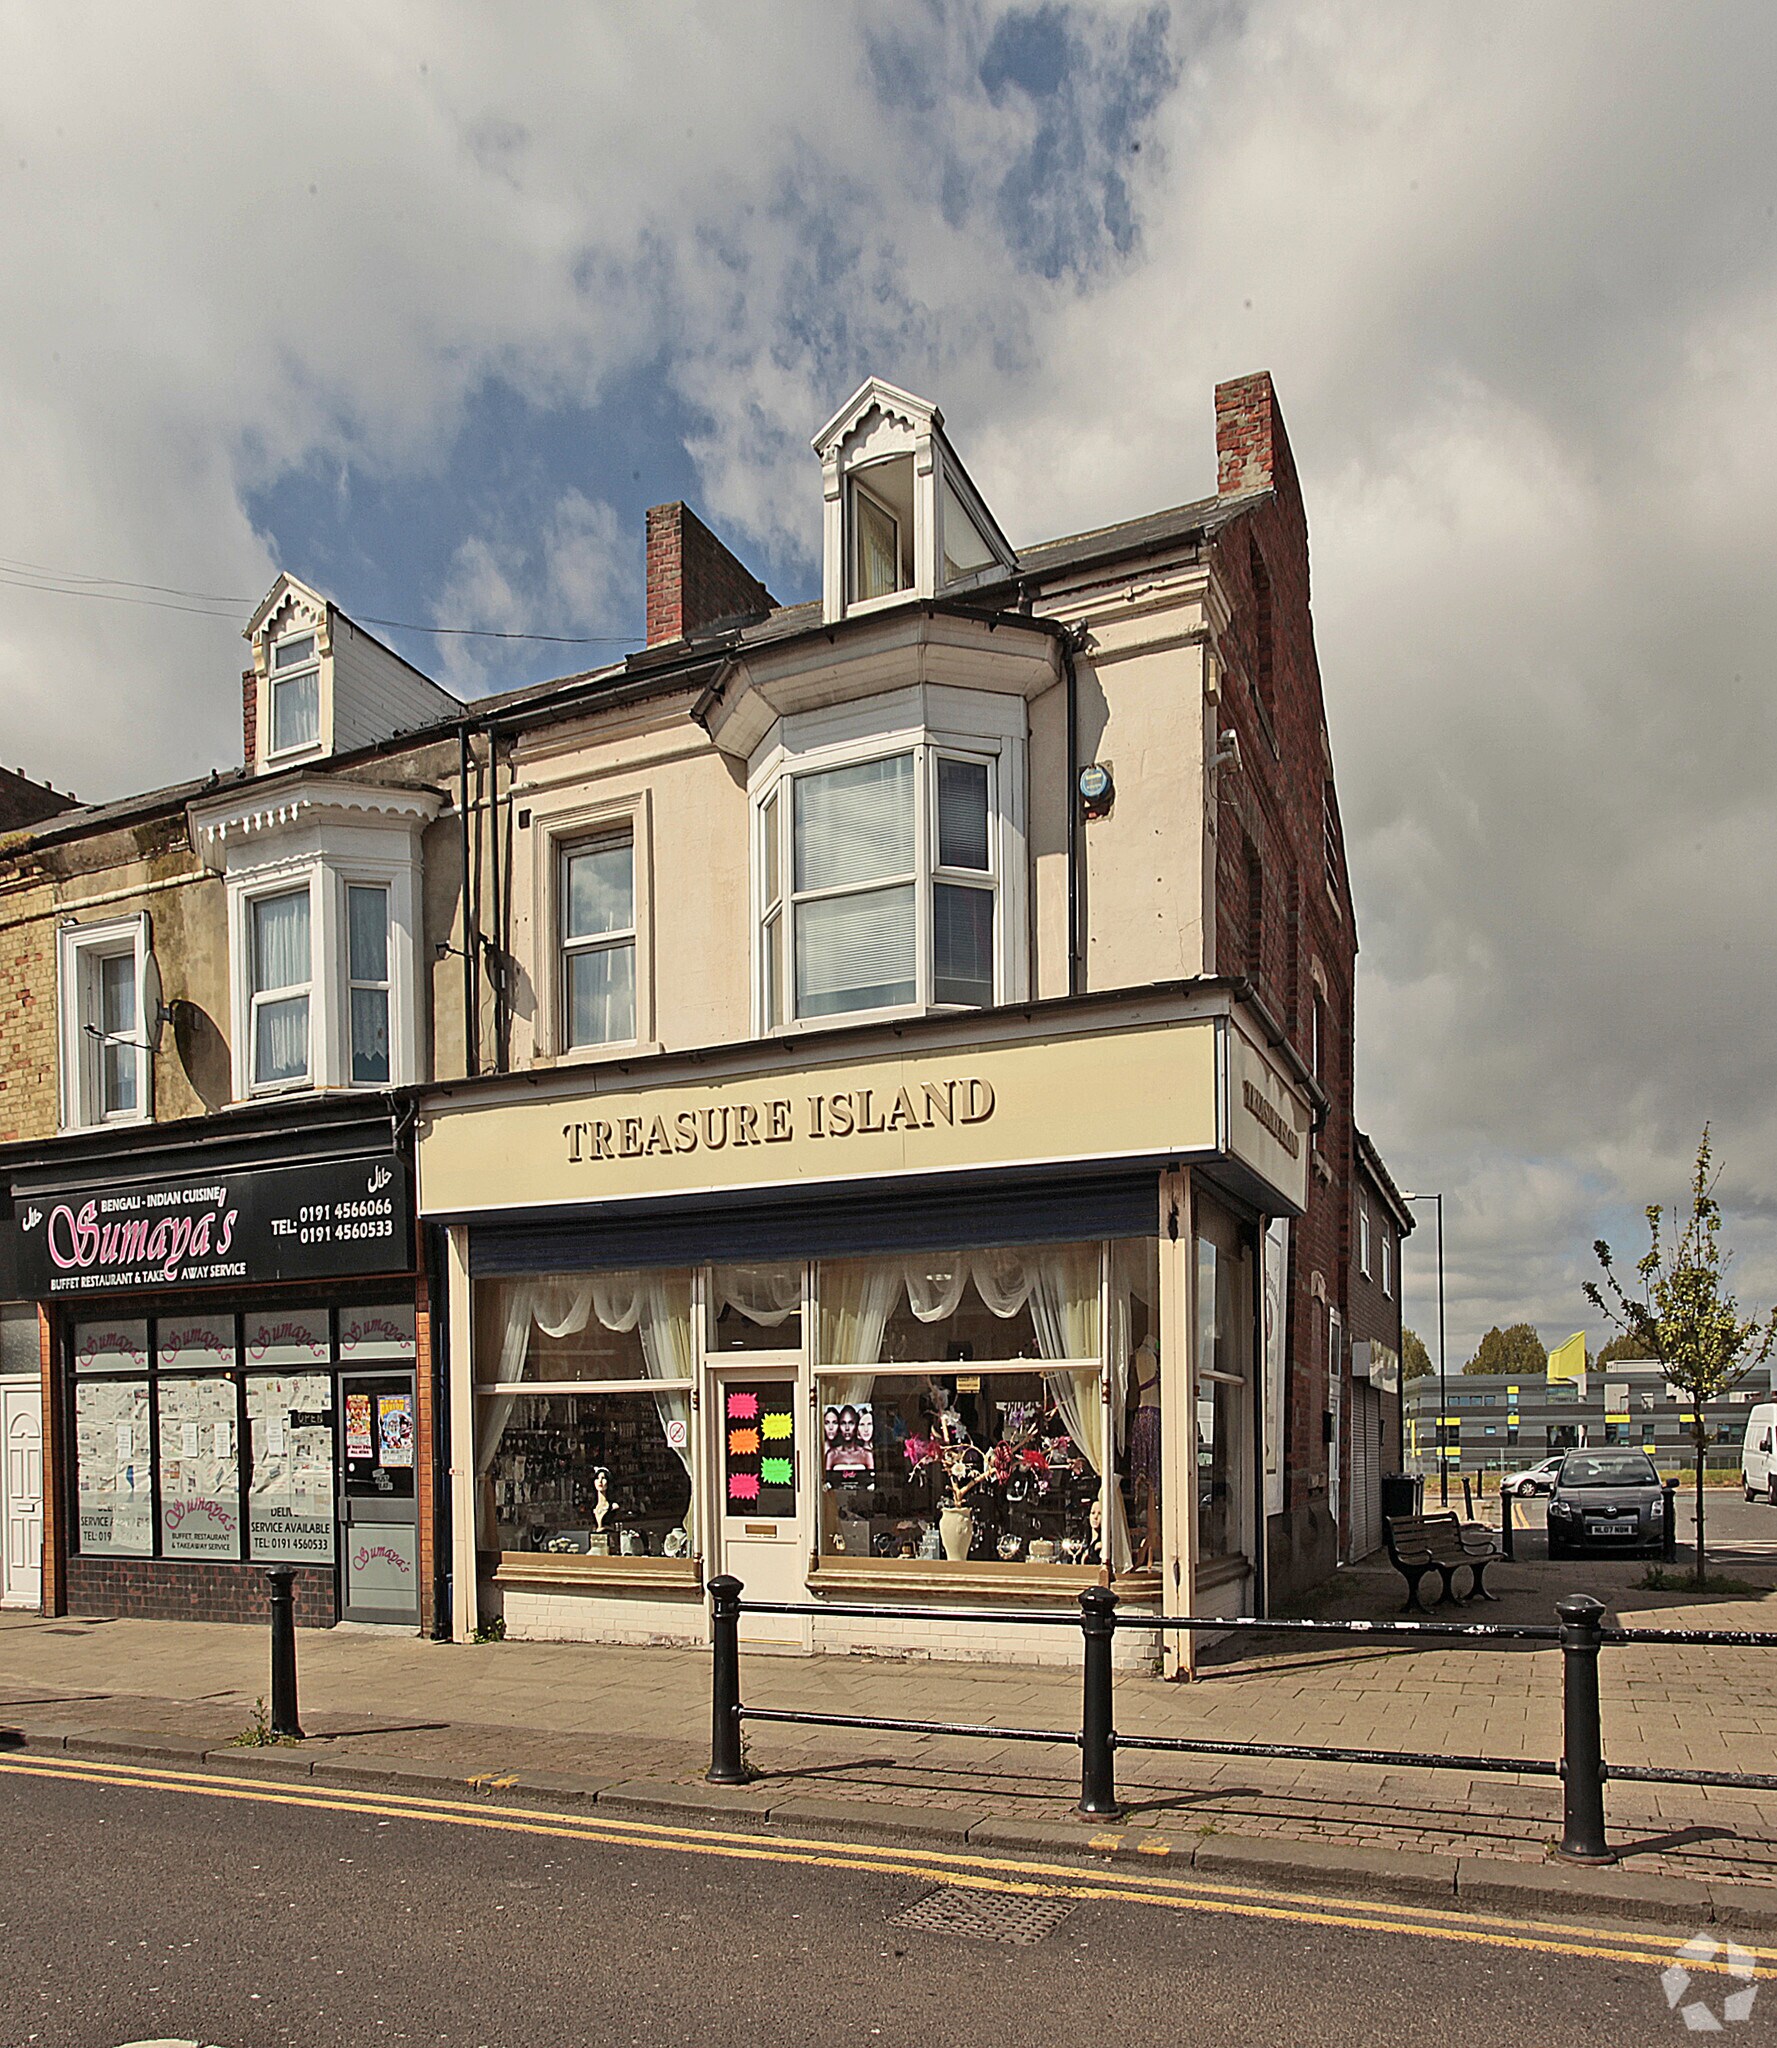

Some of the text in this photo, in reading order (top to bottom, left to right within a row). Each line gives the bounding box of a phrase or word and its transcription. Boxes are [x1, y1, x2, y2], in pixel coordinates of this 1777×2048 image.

[562, 1076, 996, 1163] TREASURE ISLAND
[101, 1186, 220, 1213] BENGALI INDIAN CUISINE
[300, 1198, 392, 1223] 0191 4566066
[48, 1187, 238, 1282] Sumaya's
[271, 1218, 298, 1236] TEL:
[300, 1219, 393, 1244] 0191 4560533
[50, 1262, 247, 1291] BUFFET RESTAURANT & TAKE AWAY SERVICE
[81, 1516, 109, 1527] SERVICE
[251, 1522, 330, 1534] SERVICE AVAILABLE
[83, 1531, 98, 1541] TEL:
[254, 1537, 328, 1550] TEL: 0191 4560533
